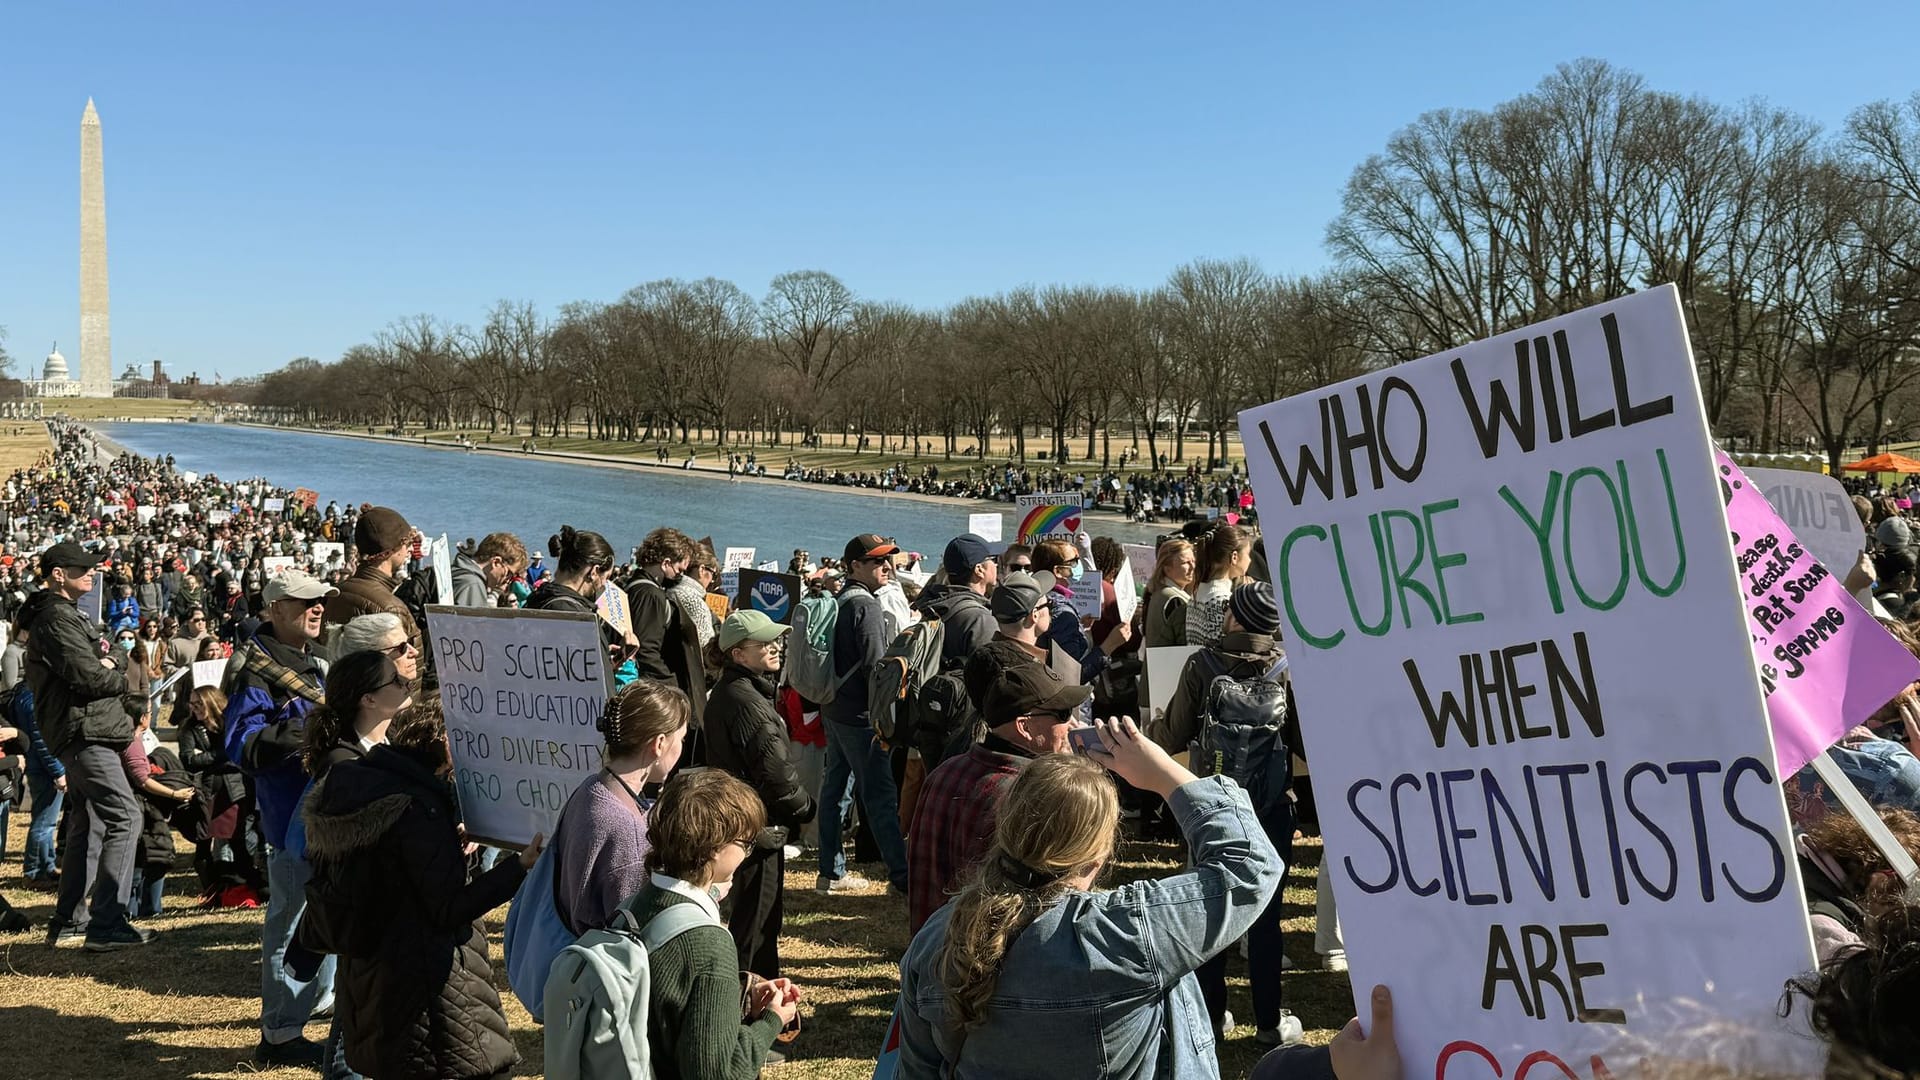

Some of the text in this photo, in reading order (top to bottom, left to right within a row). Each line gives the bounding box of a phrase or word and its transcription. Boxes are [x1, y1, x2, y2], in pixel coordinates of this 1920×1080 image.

[1259, 313, 1674, 506] WHO WILL
[1020, 495, 1080, 507] STRENGTH IN
[1279, 448, 1687, 650] CURE YOU
[1749, 543, 1804, 597] deaths
[1752, 594, 1796, 635] Pet
[439, 636, 598, 682] PRO SCIENCE
[444, 683, 602, 726] PRO EDUCATION
[1402, 632, 1605, 748] WHEN
[451, 728, 606, 771] PRO DIVERSITY
[459, 768, 501, 802] PRO
[1344, 757, 1786, 905] SCIENTISTS
[1481, 924, 1627, 1025] ARE
